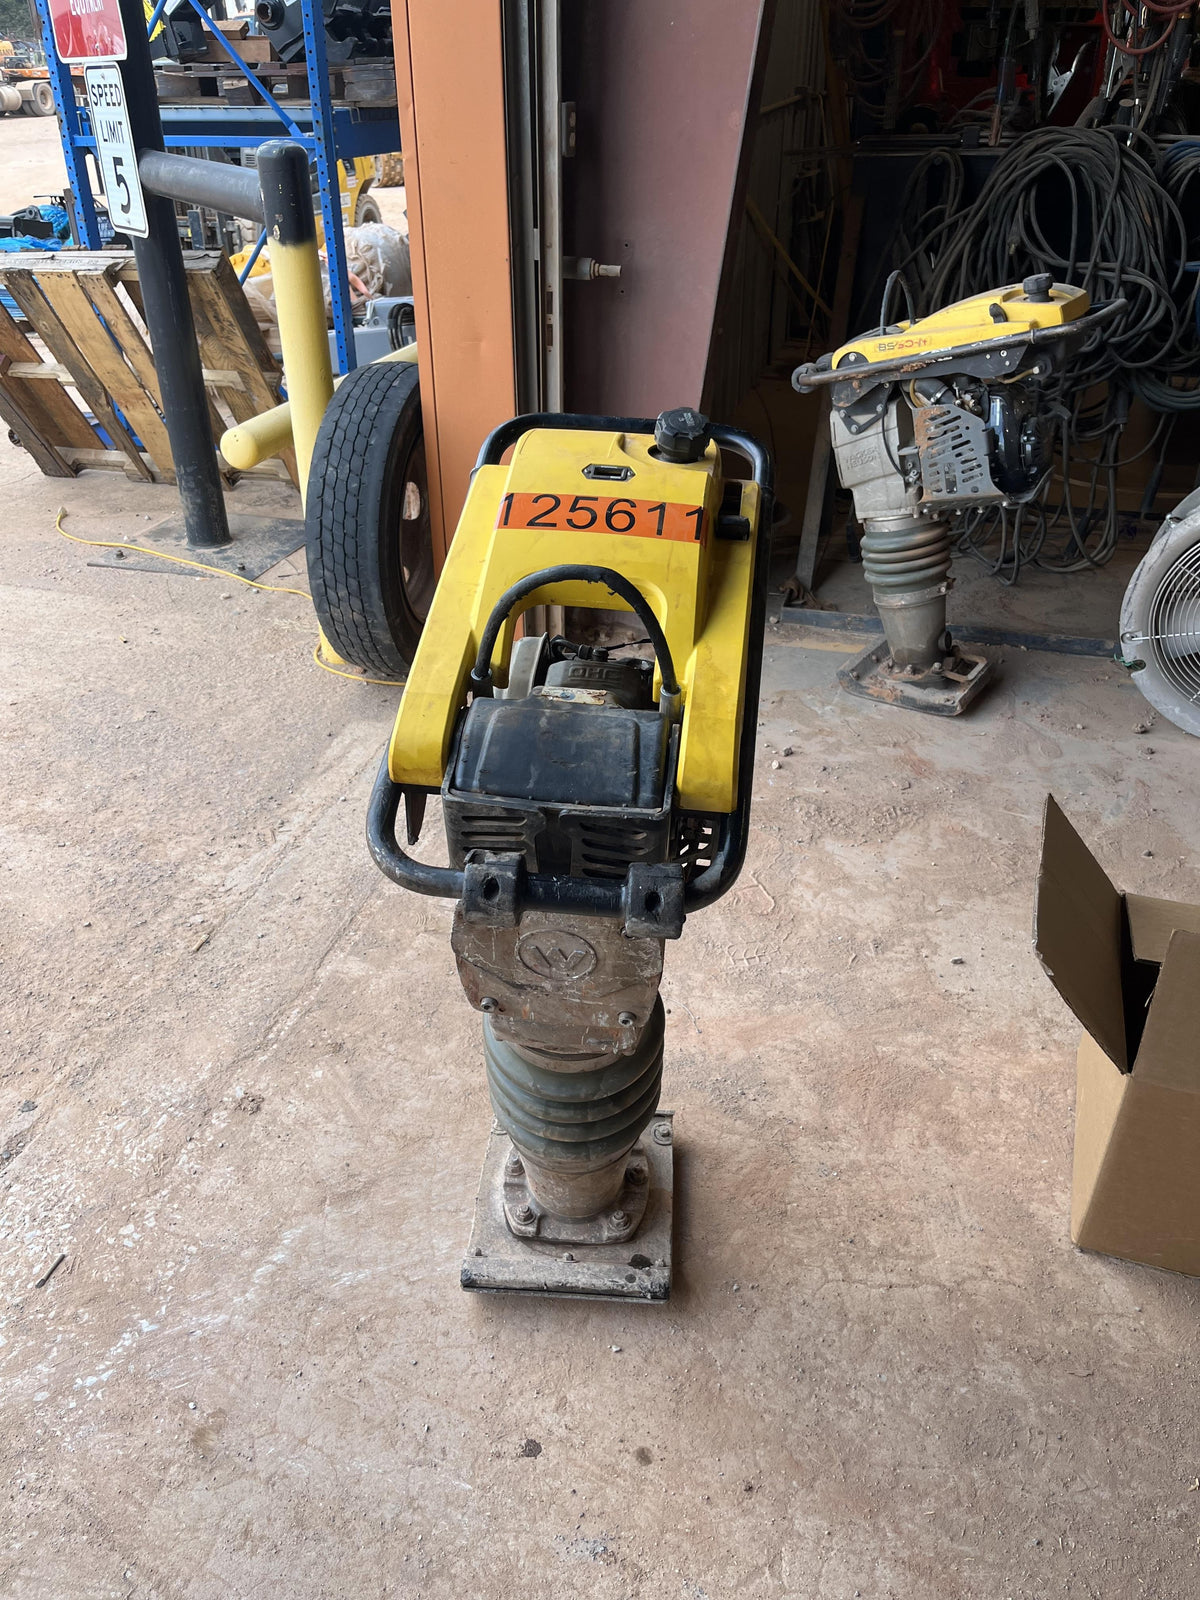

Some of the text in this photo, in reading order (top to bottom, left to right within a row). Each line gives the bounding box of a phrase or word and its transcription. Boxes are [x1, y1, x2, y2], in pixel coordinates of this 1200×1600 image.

[91, 84, 122, 107] SPEED
[100, 121, 125, 144] LIMIT
[112, 156, 131, 215] 5
[500, 492, 704, 541] 125611
